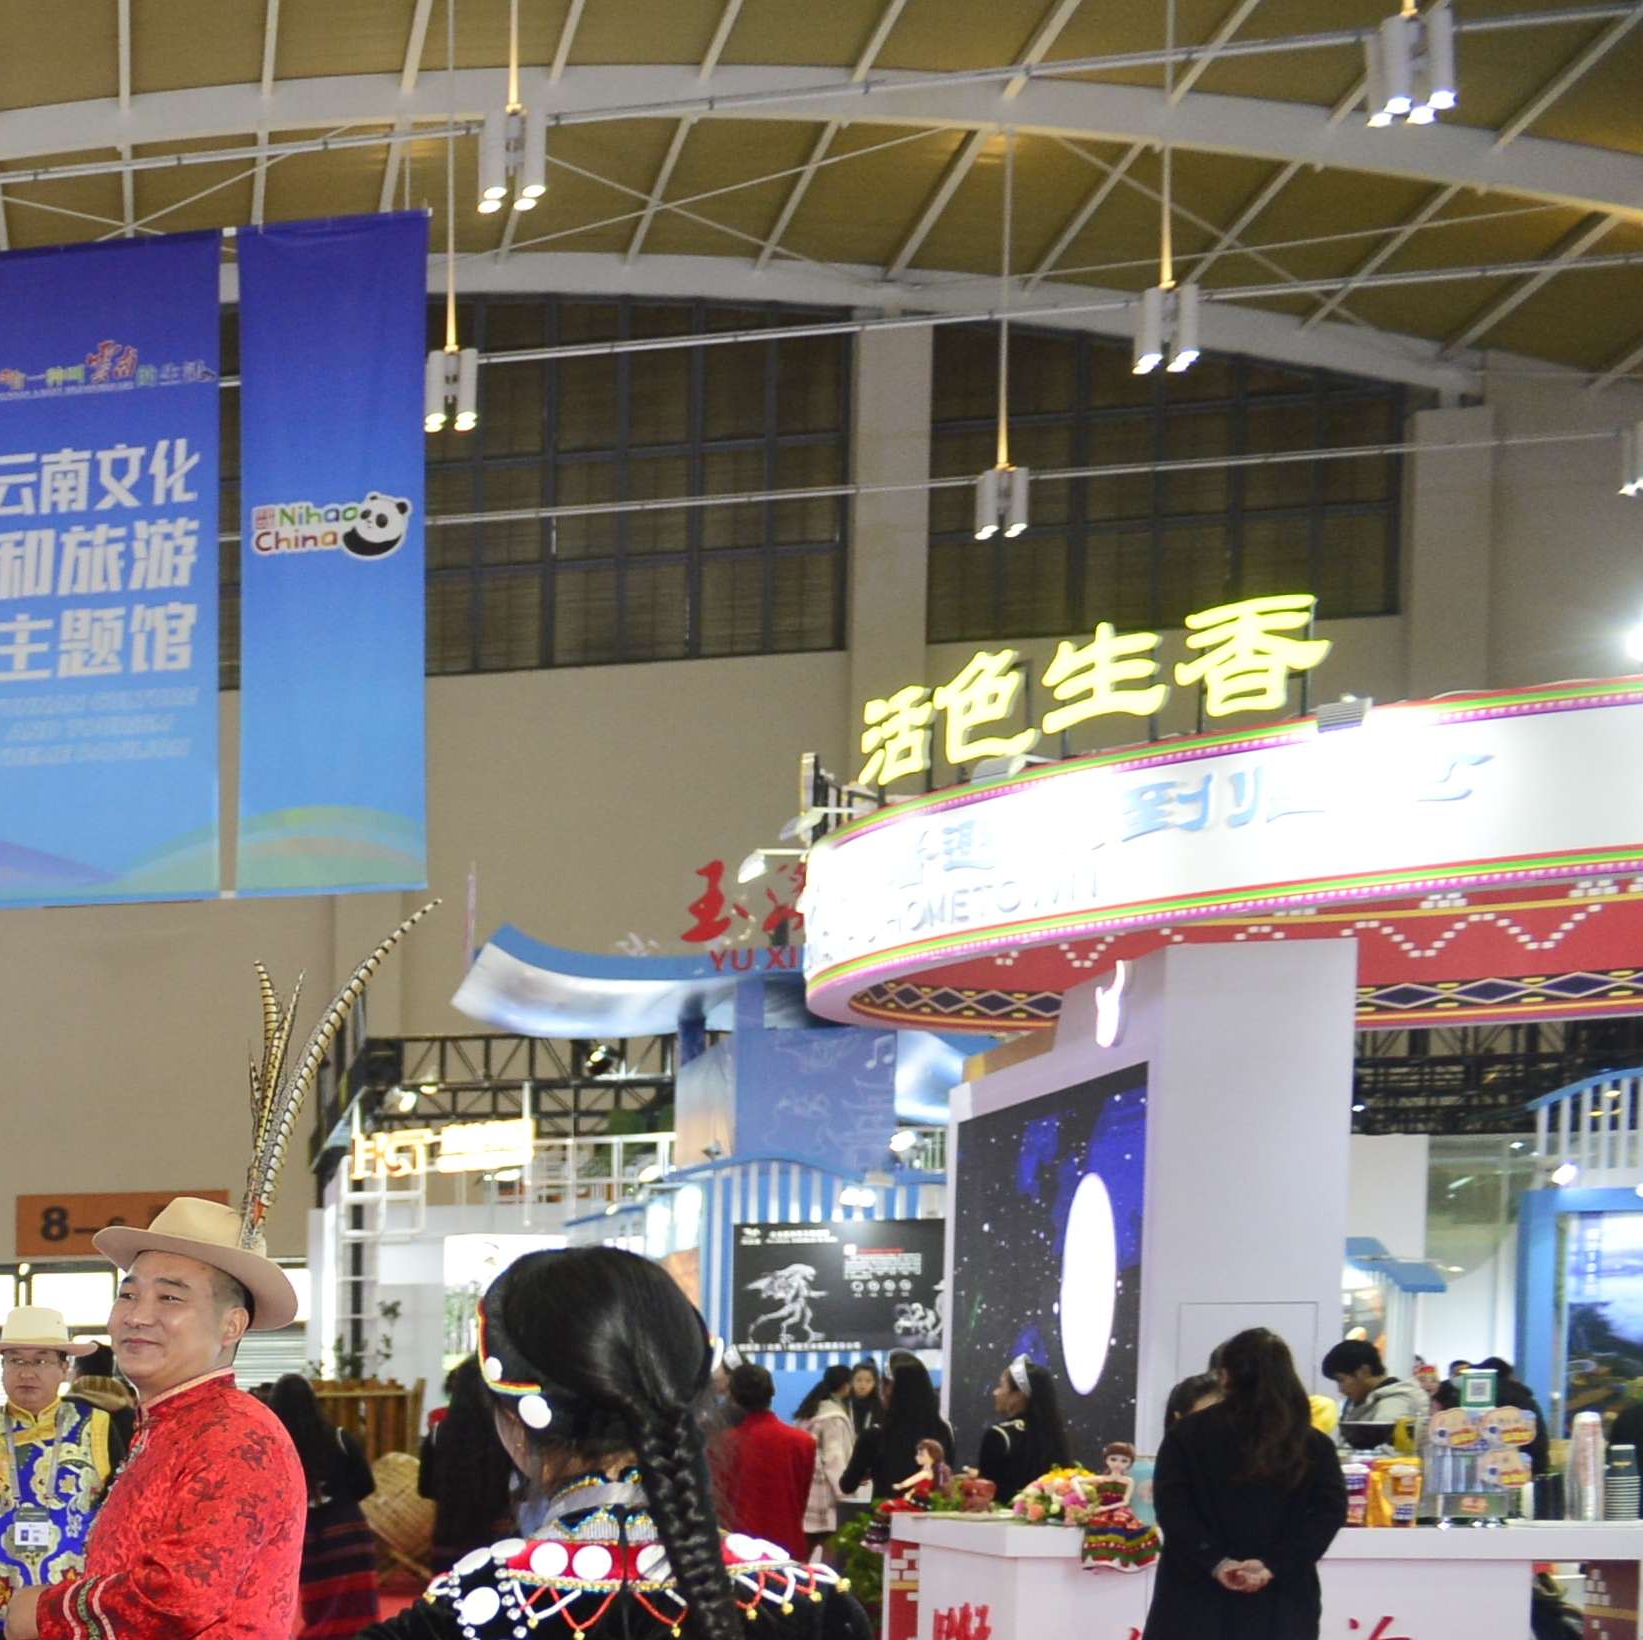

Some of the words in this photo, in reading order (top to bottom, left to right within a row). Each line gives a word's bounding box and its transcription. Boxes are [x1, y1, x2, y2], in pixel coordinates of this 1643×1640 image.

[279, 506, 359, 528] Nihao
[255, 530, 338, 552] China
[859, 593, 1331, 787] 活色生香
[710, 948, 754, 972] YU
[765, 946, 797, 970] XI
